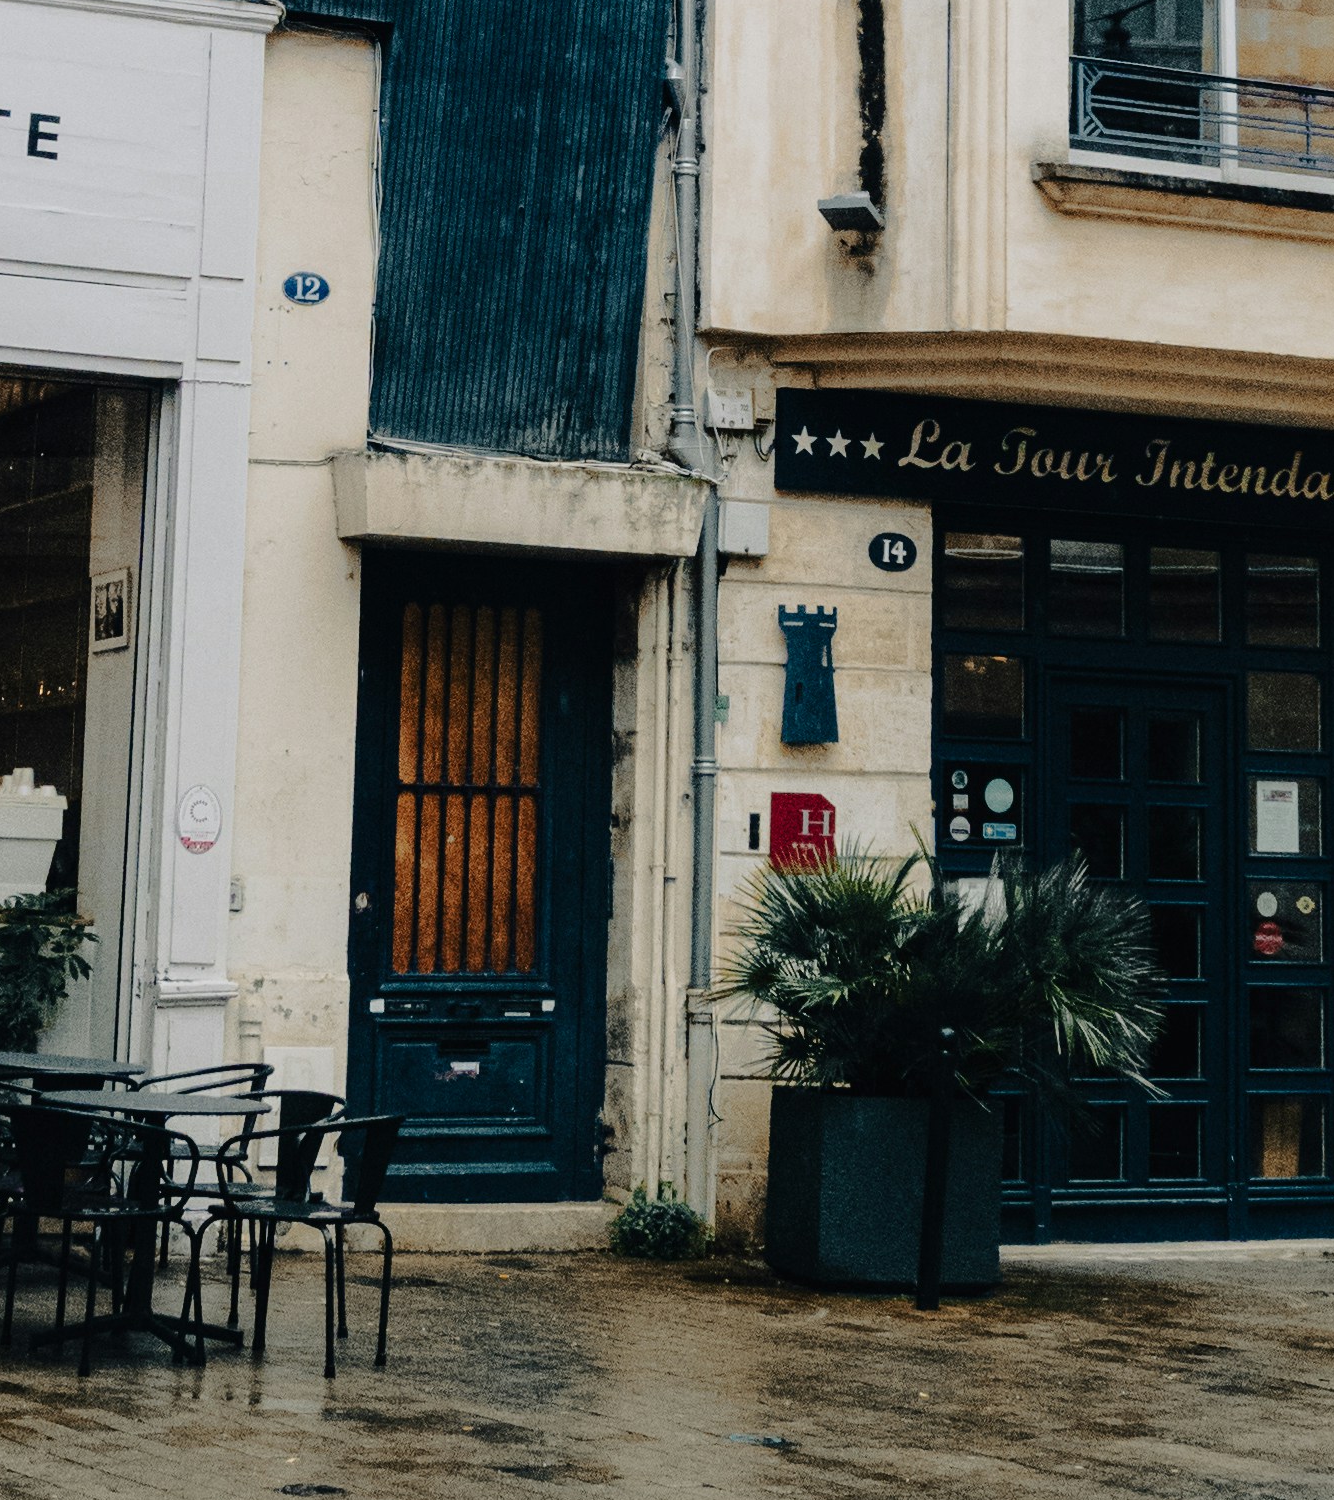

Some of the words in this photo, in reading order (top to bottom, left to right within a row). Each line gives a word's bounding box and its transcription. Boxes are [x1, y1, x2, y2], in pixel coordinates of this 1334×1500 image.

[294, 276, 321, 300] 12
[898, 418, 976, 472] La
[994, 427, 1118, 483] Tour
[882, 538, 908, 565] 14
[798, 809, 834, 837] H
